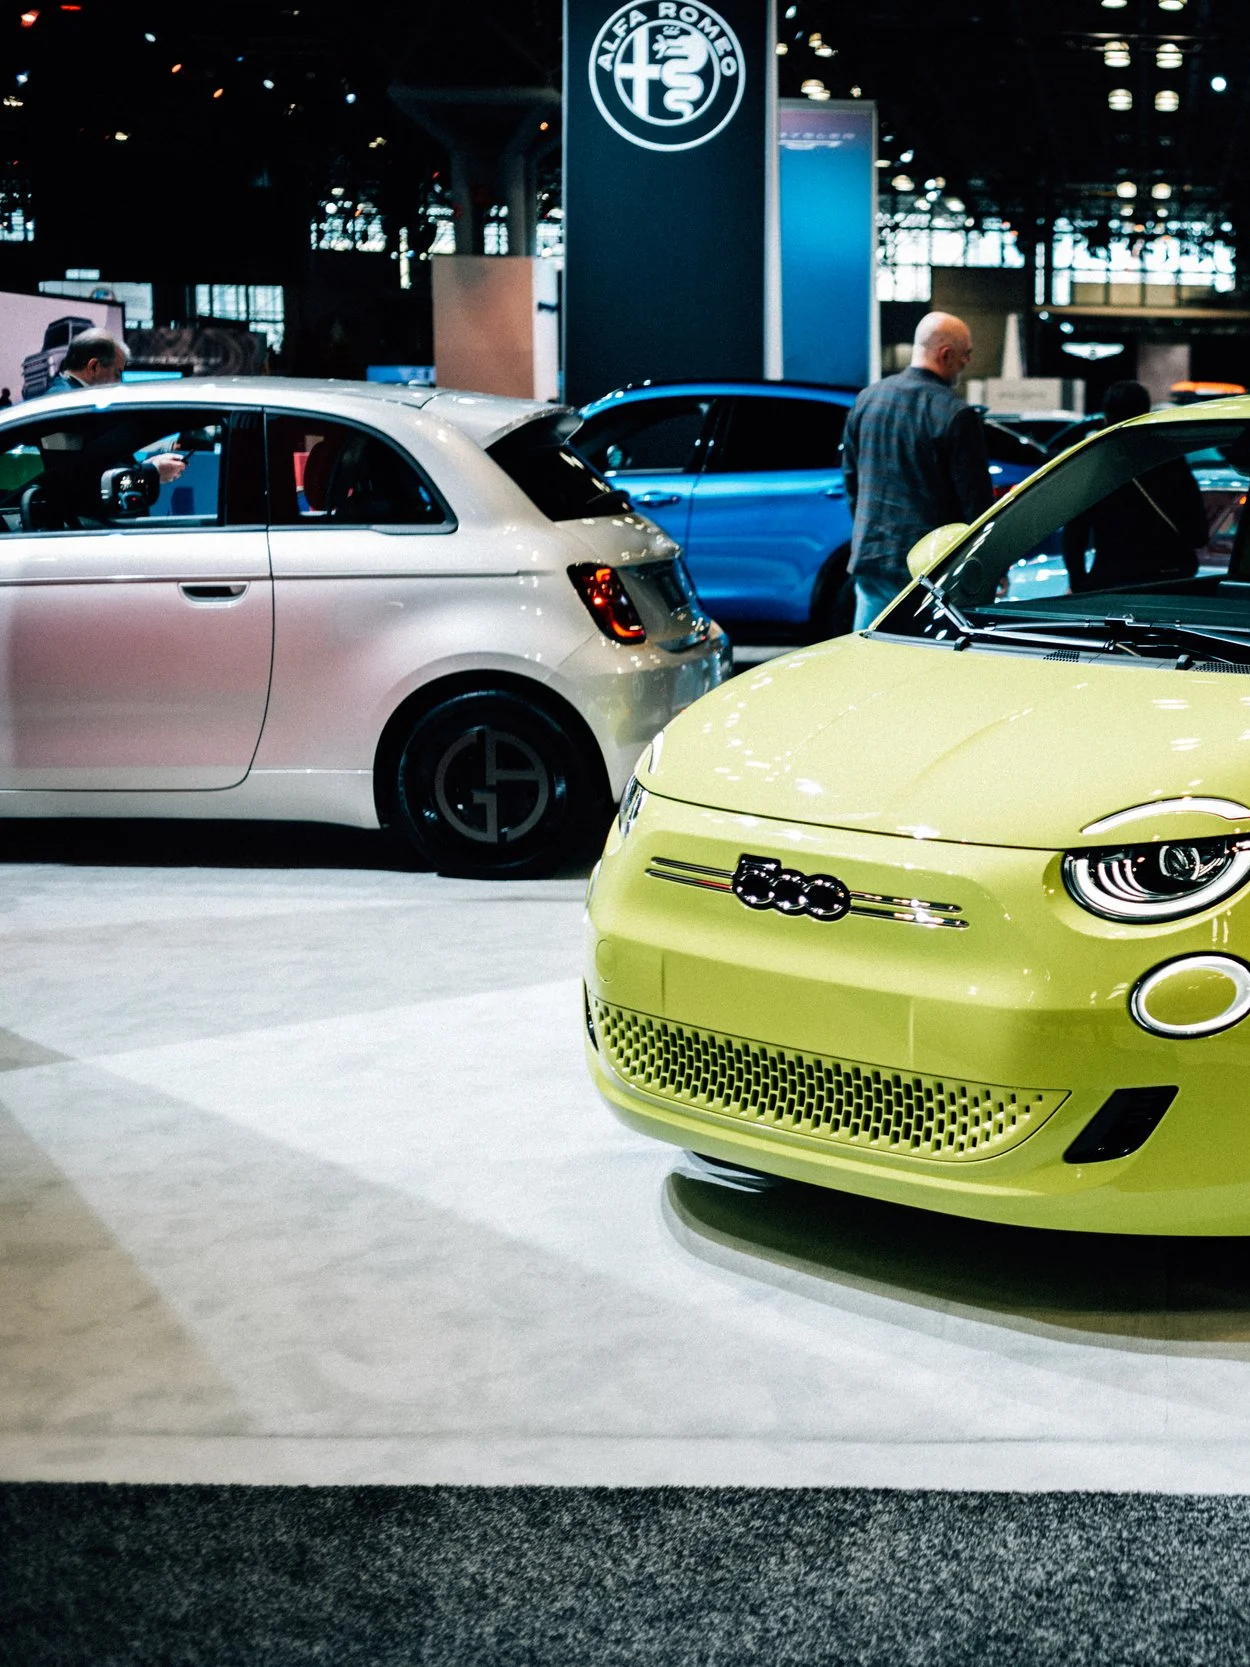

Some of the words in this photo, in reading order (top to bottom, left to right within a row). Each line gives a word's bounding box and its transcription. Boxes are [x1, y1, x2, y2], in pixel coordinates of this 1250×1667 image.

[596, 9, 648, 72] ALFA
[657, 2, 738, 77] ROMEO
[732, 853, 851, 922] 500
